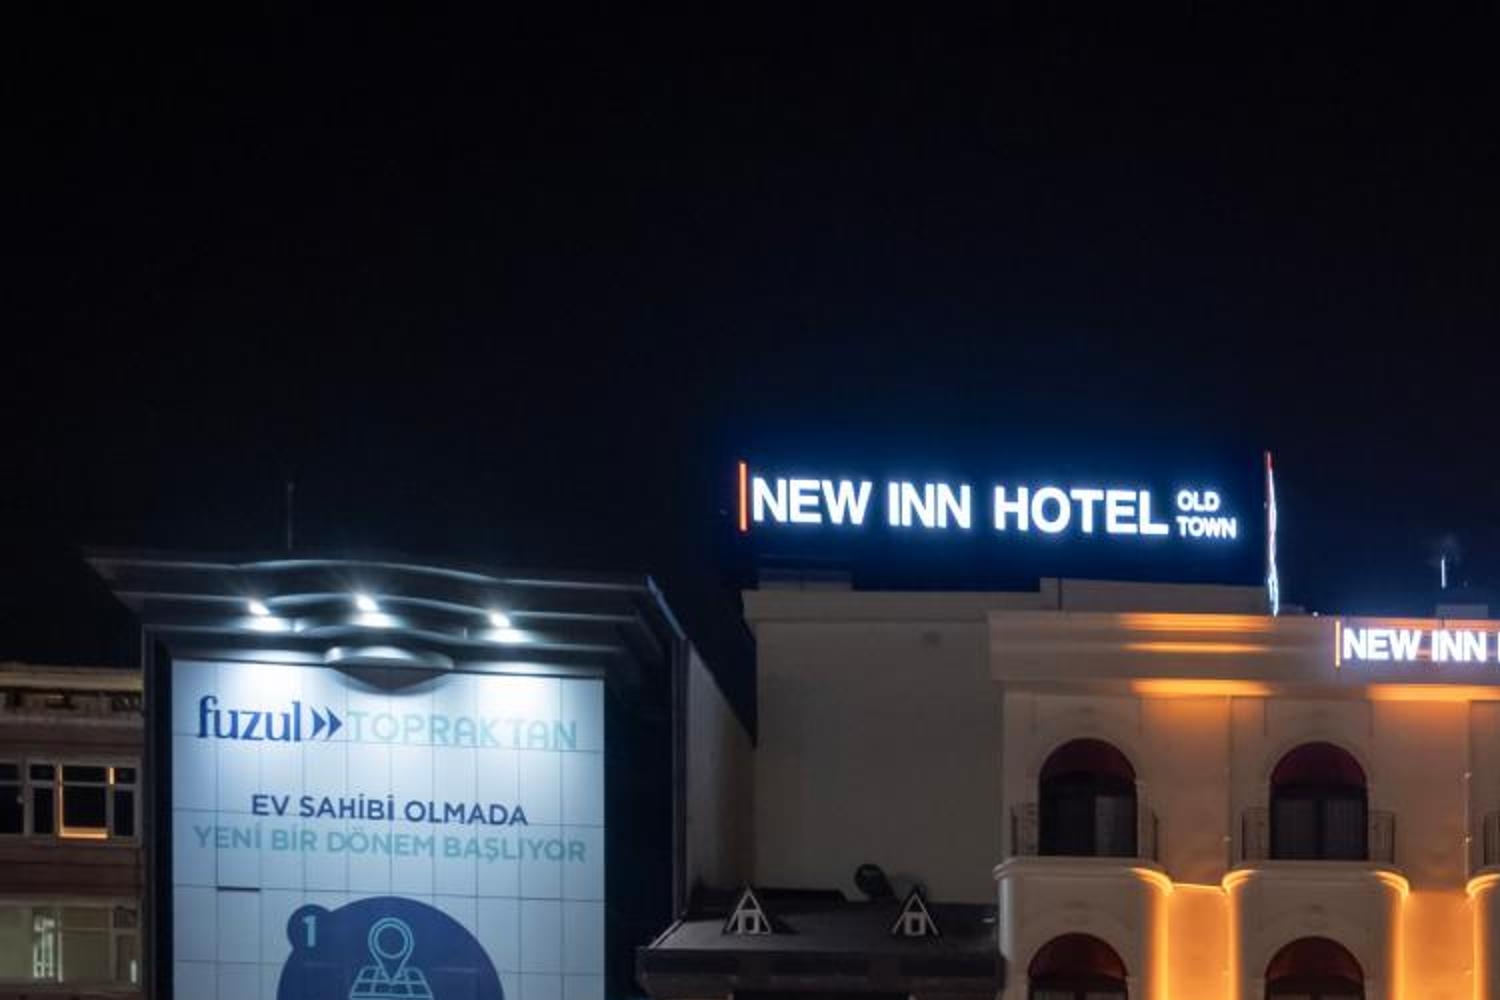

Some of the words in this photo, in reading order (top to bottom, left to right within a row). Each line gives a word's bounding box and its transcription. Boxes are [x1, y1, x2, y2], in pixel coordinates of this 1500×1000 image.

[752, 477, 870, 524] NEW
[888, 482, 971, 529] INN
[993, 484, 1169, 534] HOTEL
[1177, 491, 1220, 510] OLD
[1176, 516, 1236, 538] TOWN
[1343, 628, 1420, 660] NEW
[1432, 630, 1487, 662] INN
[199, 695, 301, 742] fuzul
[347, 710, 577, 750] TOPRAKTAN
[252, 795, 290, 816] EV
[300, 793, 395, 821] SAHİBİ
[405, 801, 528, 825] OLMADA
[194, 822, 262, 849] YENİ
[271, 823, 317, 850] BİR
[327, 827, 435, 857] DÖNEM
[446, 836, 586, 863] BAŞLIYOR
[303, 916, 316, 947] 1
